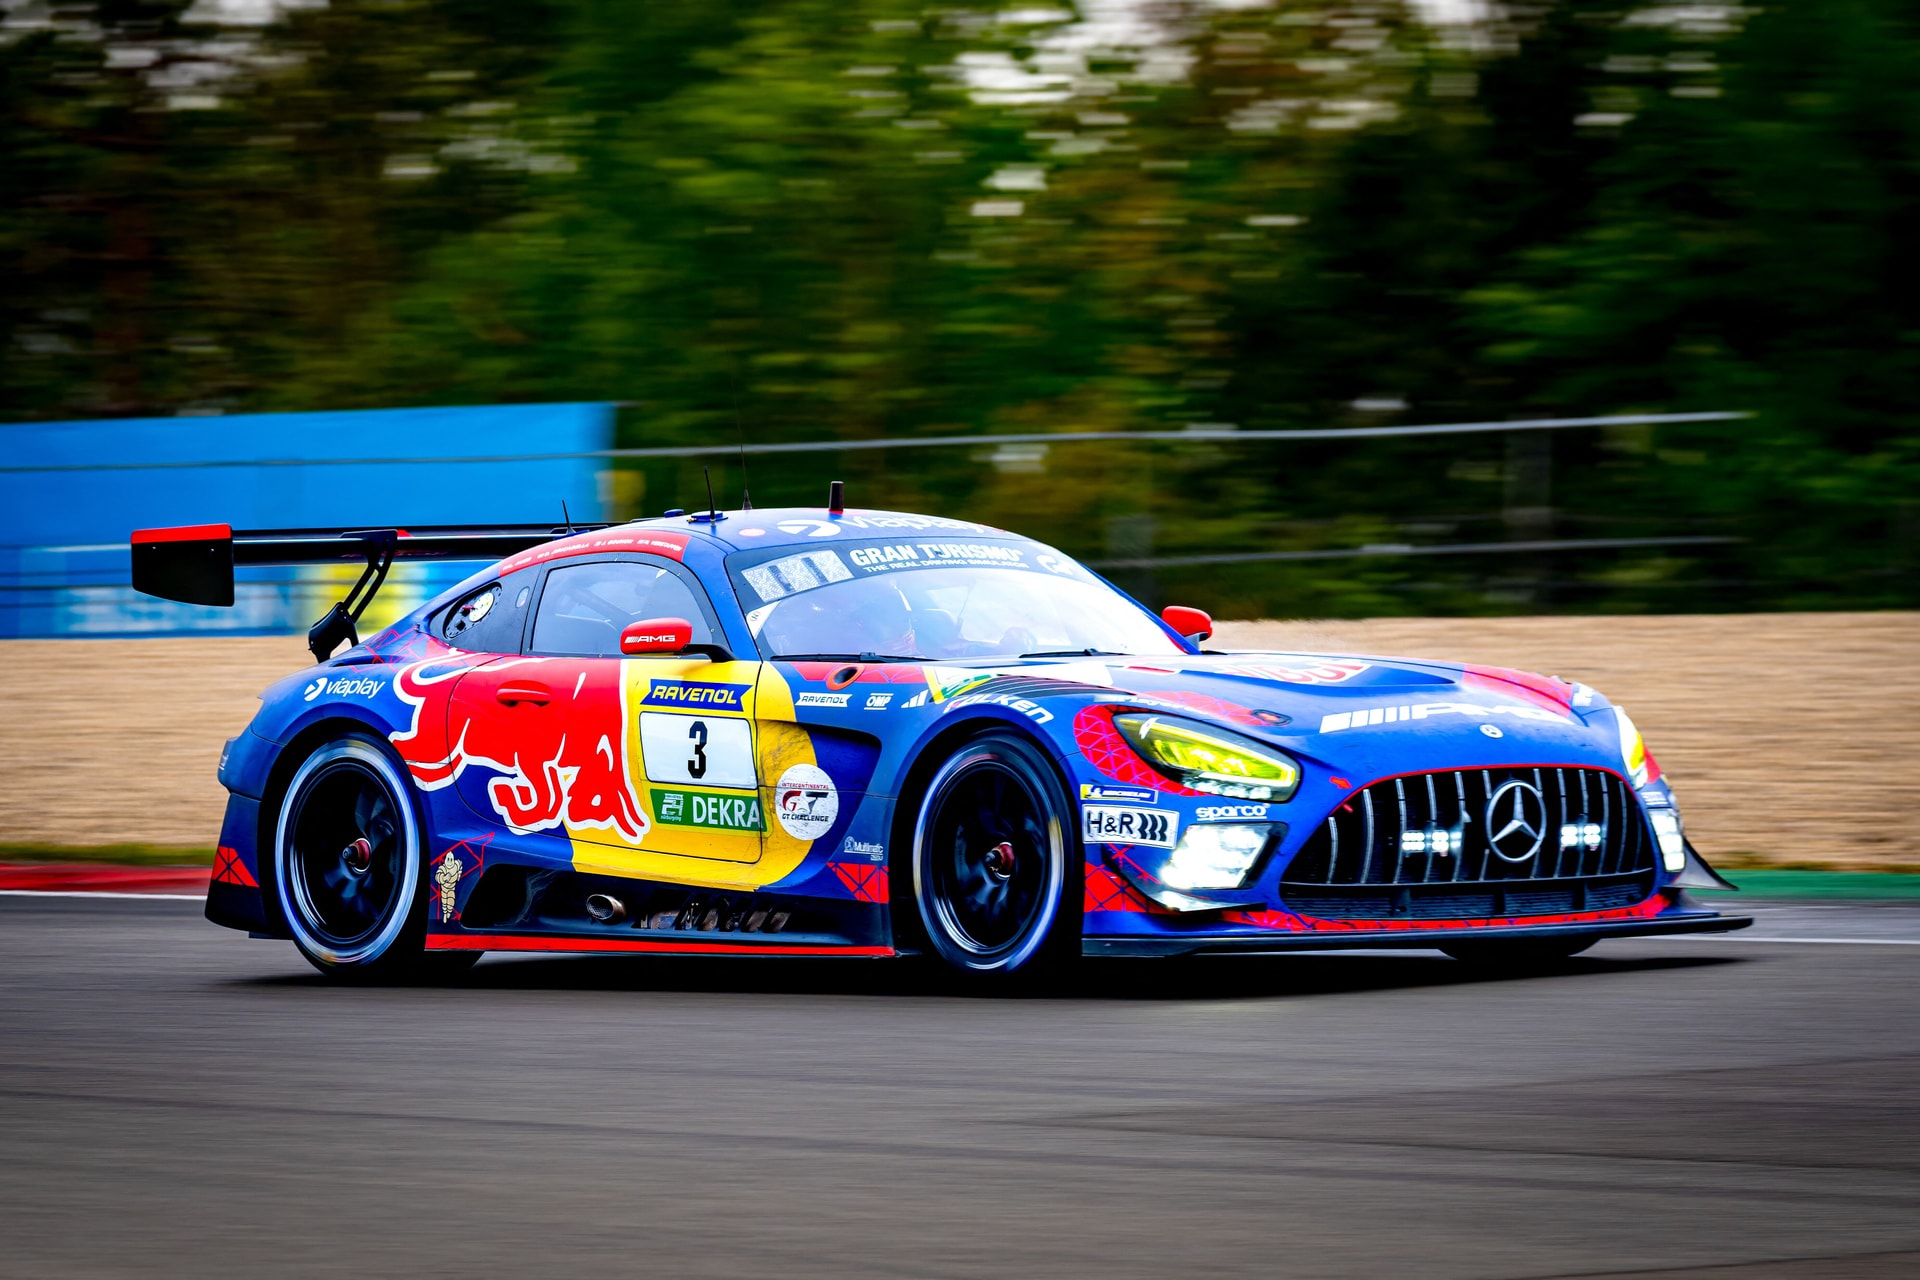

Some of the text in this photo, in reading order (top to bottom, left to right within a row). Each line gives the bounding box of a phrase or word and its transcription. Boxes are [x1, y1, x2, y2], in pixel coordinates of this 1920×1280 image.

[850, 544, 919, 567] GRAN
[863, 565, 889, 573] THE
[891, 561, 919, 570] REAL
[638, 635, 676, 643] AMG
[326, 677, 386, 699] viaplay
[651, 685, 738, 705] RAVENOL
[801, 695, 845, 704] RAVENOL
[866, 695, 891, 707] OMP
[687, 720, 709, 779] 3
[782, 782, 829, 790] INTERCONTINENTAL
[692, 796, 764, 828] DEKRA
[791, 813, 829, 822] CHALLENGE
[1195, 805, 1266, 820] sparco
[1087, 810, 1134, 835] H&R
